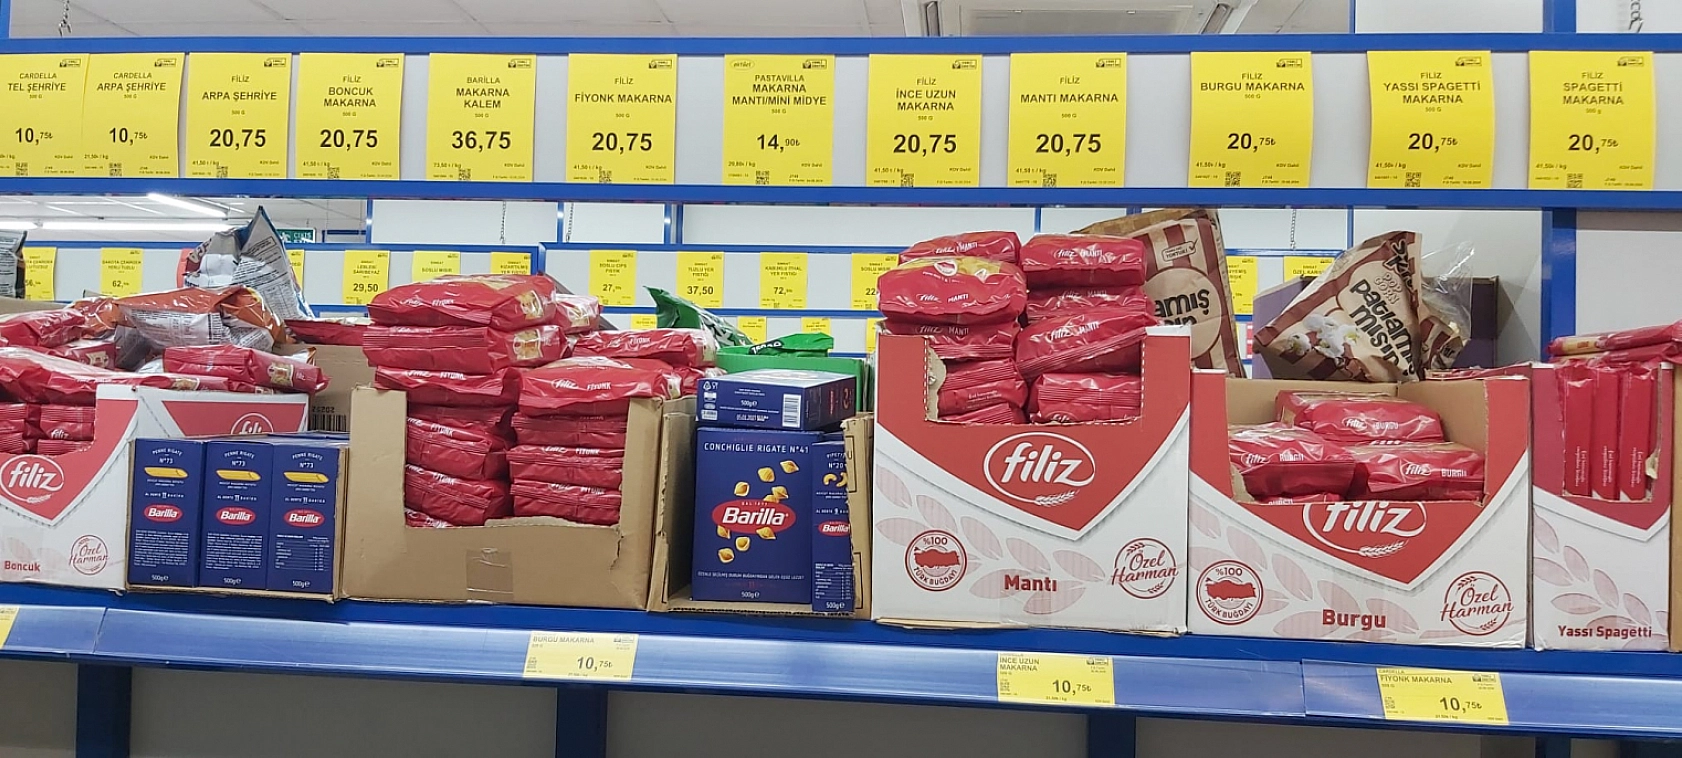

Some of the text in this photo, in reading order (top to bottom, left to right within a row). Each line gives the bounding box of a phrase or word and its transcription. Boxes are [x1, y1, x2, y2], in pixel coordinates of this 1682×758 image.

[467, 75, 500, 84] BARİLLA
[614, 76, 634, 84] FİLİZ
[1060, 75, 1080, 84] FİLİZ
[8, 82, 66, 93] TEL ŞEHRİYE
[97, 82, 166, 93] ARPA ŞEHRİYE
[329, 87, 373, 95] BONCUK
[753, 84, 806, 93] MAKARNA
[1200, 83, 1305, 91] BURGU MAKARNA
[1384, 81, 1480, 91] YASSI SPAGETTİ
[1563, 82, 1623, 92] SPAGETTİ
[233, 91, 277, 101] ŞEHRİYE
[575, 92, 672, 103] FİYONK MAKARNA
[896, 88, 956, 98] İNCE UZUN
[733, 95, 826, 105] MANTI/MİNİ MİDYE
[1021, 94, 1118, 103] MANTI MAKARNA
[1403, 95, 1463, 103] MAKARNA
[1563, 96, 1624, 104] MAKARNA
[464, 100, 501, 108] KALEM
[897, 102, 954, 110] MAKARNA
[210, 129, 266, 150] 20,75
[320, 130, 378, 150] 20,75
[452, 131, 511, 152] 36,75
[592, 133, 652, 154] 20,75
[893, 135, 956, 156] 20,75
[1036, 134, 1102, 156] 20,75
[353, 283, 378, 292] 29,50
[687, 286, 713, 294] 37,50
[948, 294, 969, 302] MANTI
[1154, 288, 1210, 315] amış
[948, 326, 969, 335] MANTI
[704, 443, 753, 452] CONCHIGLIE
[757, 444, 786, 452] RIGATE
[1000, 442, 1083, 483] filiz
[1404, 463, 1430, 475] filiz
[9, 460, 57, 492] filiz
[148, 508, 180, 518] Barilla
[221, 511, 252, 521] Barilla
[289, 513, 320, 523] Barilla
[722, 507, 786, 526] Barilla
[1323, 502, 1415, 534] filiz
[822, 524, 849, 533] Barilla
[923, 537, 947, 545] %100
[1129, 550, 1164, 570] Özel
[4, 561, 41, 573] Boncuk
[1215, 568, 1242, 576] %100
[914, 567, 957, 585] TÜRK BUĞDAYI
[1111, 565, 1178, 586] Harman
[1005, 574, 1057, 592] Mantı
[1460, 584, 1498, 607] Özel
[1205, 599, 1253, 618] TÜRK BUĞDAYI
[1440, 601, 1514, 622] Harman
[1322, 609, 1386, 630] Burgu
[1558, 625, 1652, 639] Yassı Spagetti
